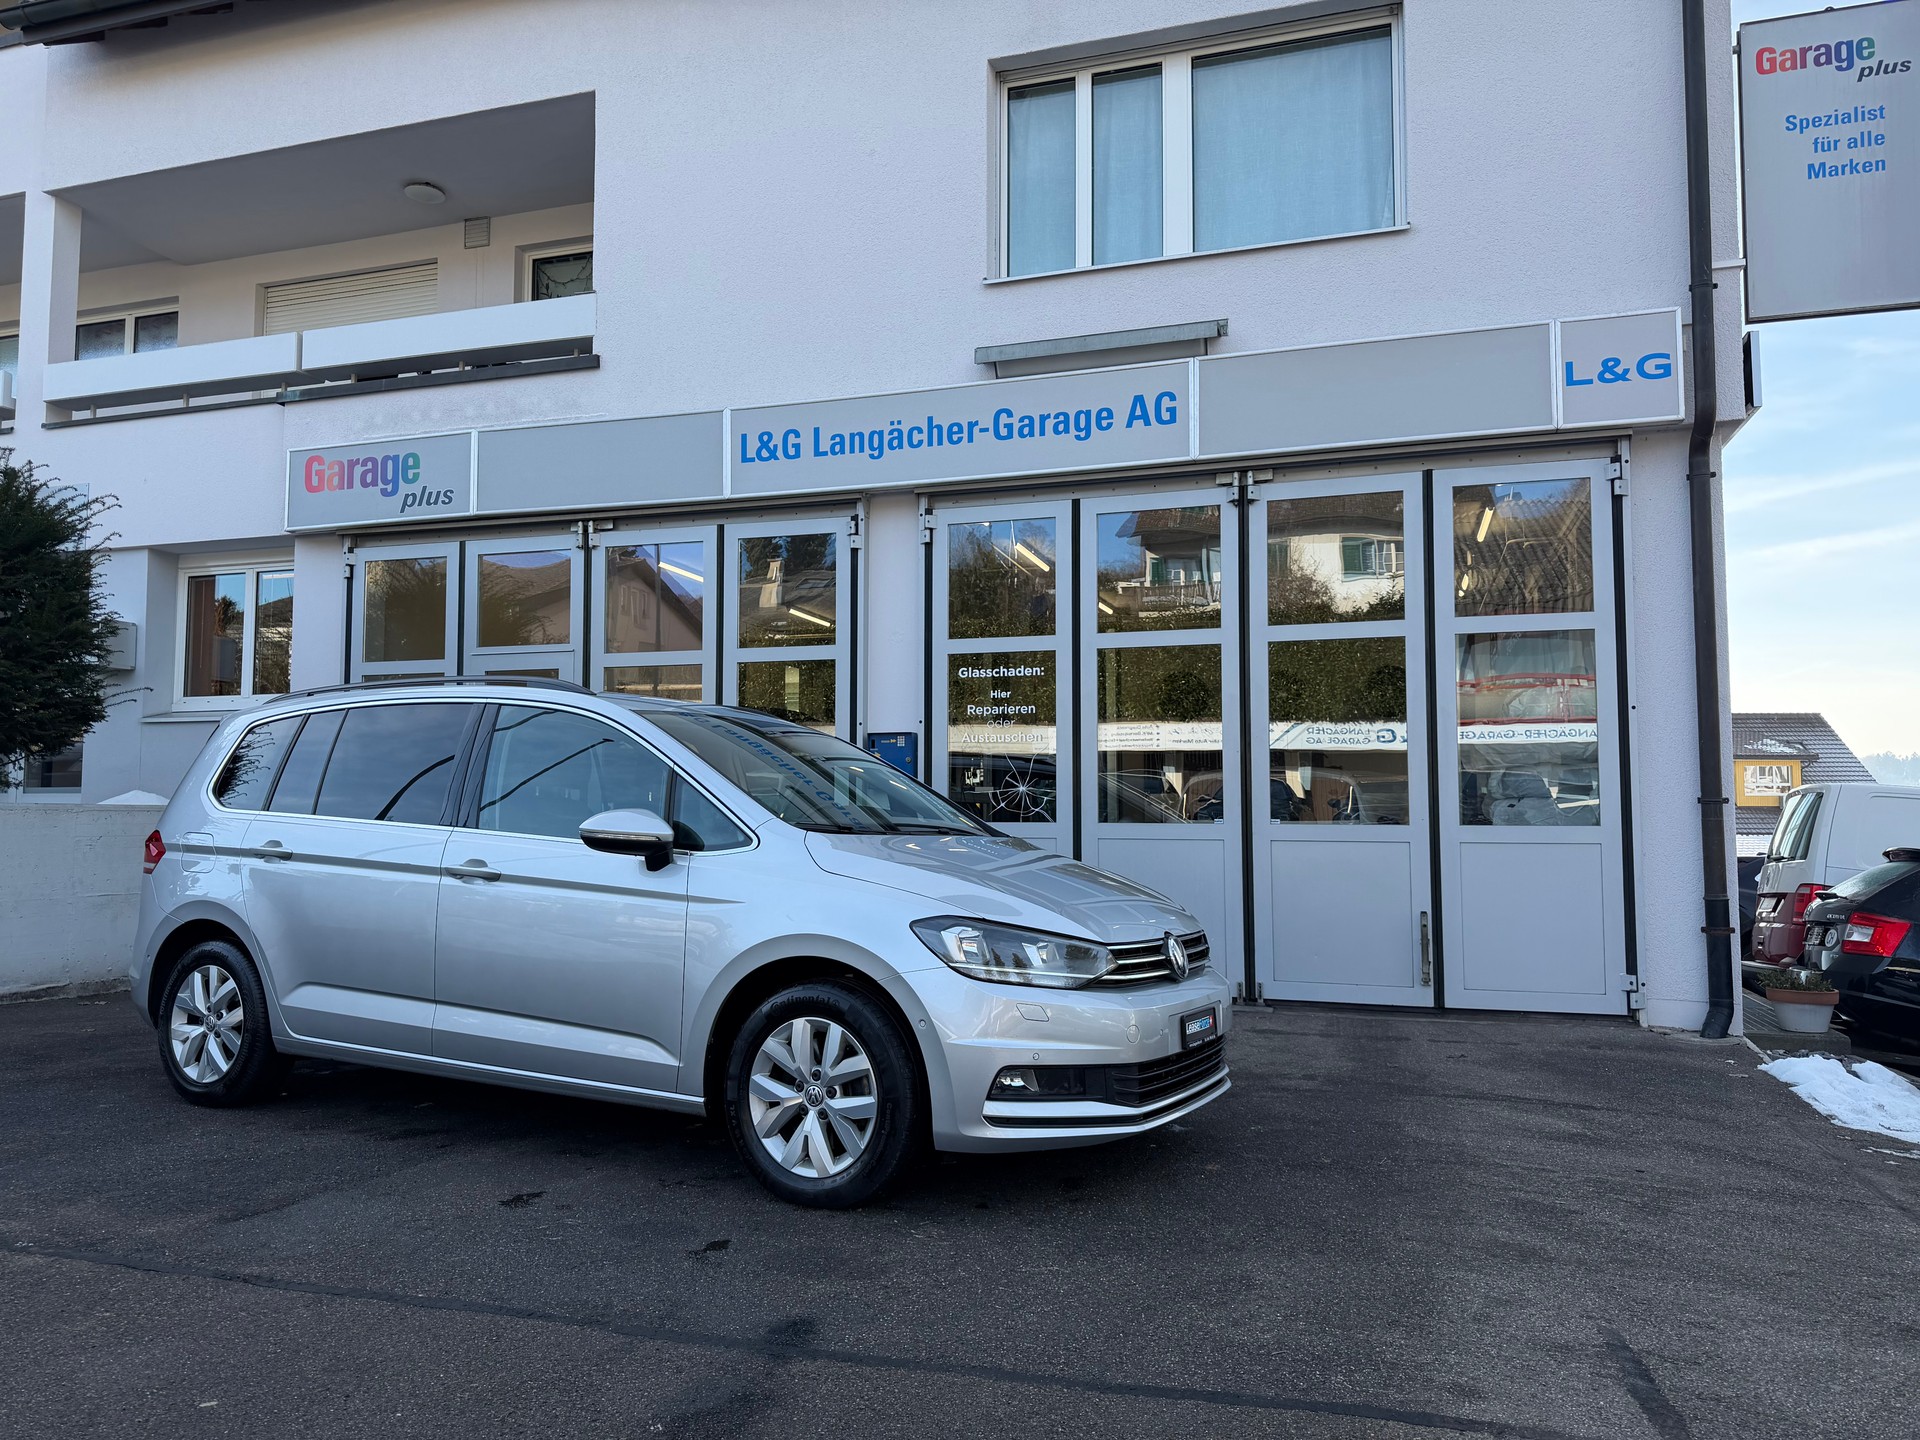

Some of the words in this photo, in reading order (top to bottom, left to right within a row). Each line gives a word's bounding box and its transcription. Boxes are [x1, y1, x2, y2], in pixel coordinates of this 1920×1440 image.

[1755, 36, 1876, 76] Garage
[1856, 59, 1912, 83] plus
[1785, 104, 1886, 135] Spezialist
[1812, 136, 1841, 154] für
[1846, 130, 1886, 150] alle
[1807, 159, 1886, 180] Marken
[1565, 352, 1672, 387] L&G
[740, 428, 801, 463] L&G
[812, 406, 1114, 460] Langächer-Garage
[1125, 391, 1178, 429] AG
[304, 451, 421, 497] Garage
[399, 485, 455, 513] plus
[958, 665, 1045, 679] Glasschaden:
[990, 689, 1011, 699] Hier
[967, 704, 1036, 717] Reparieren
[987, 718, 1016, 729] oder
[961, 731, 1043, 743] Austauschen
